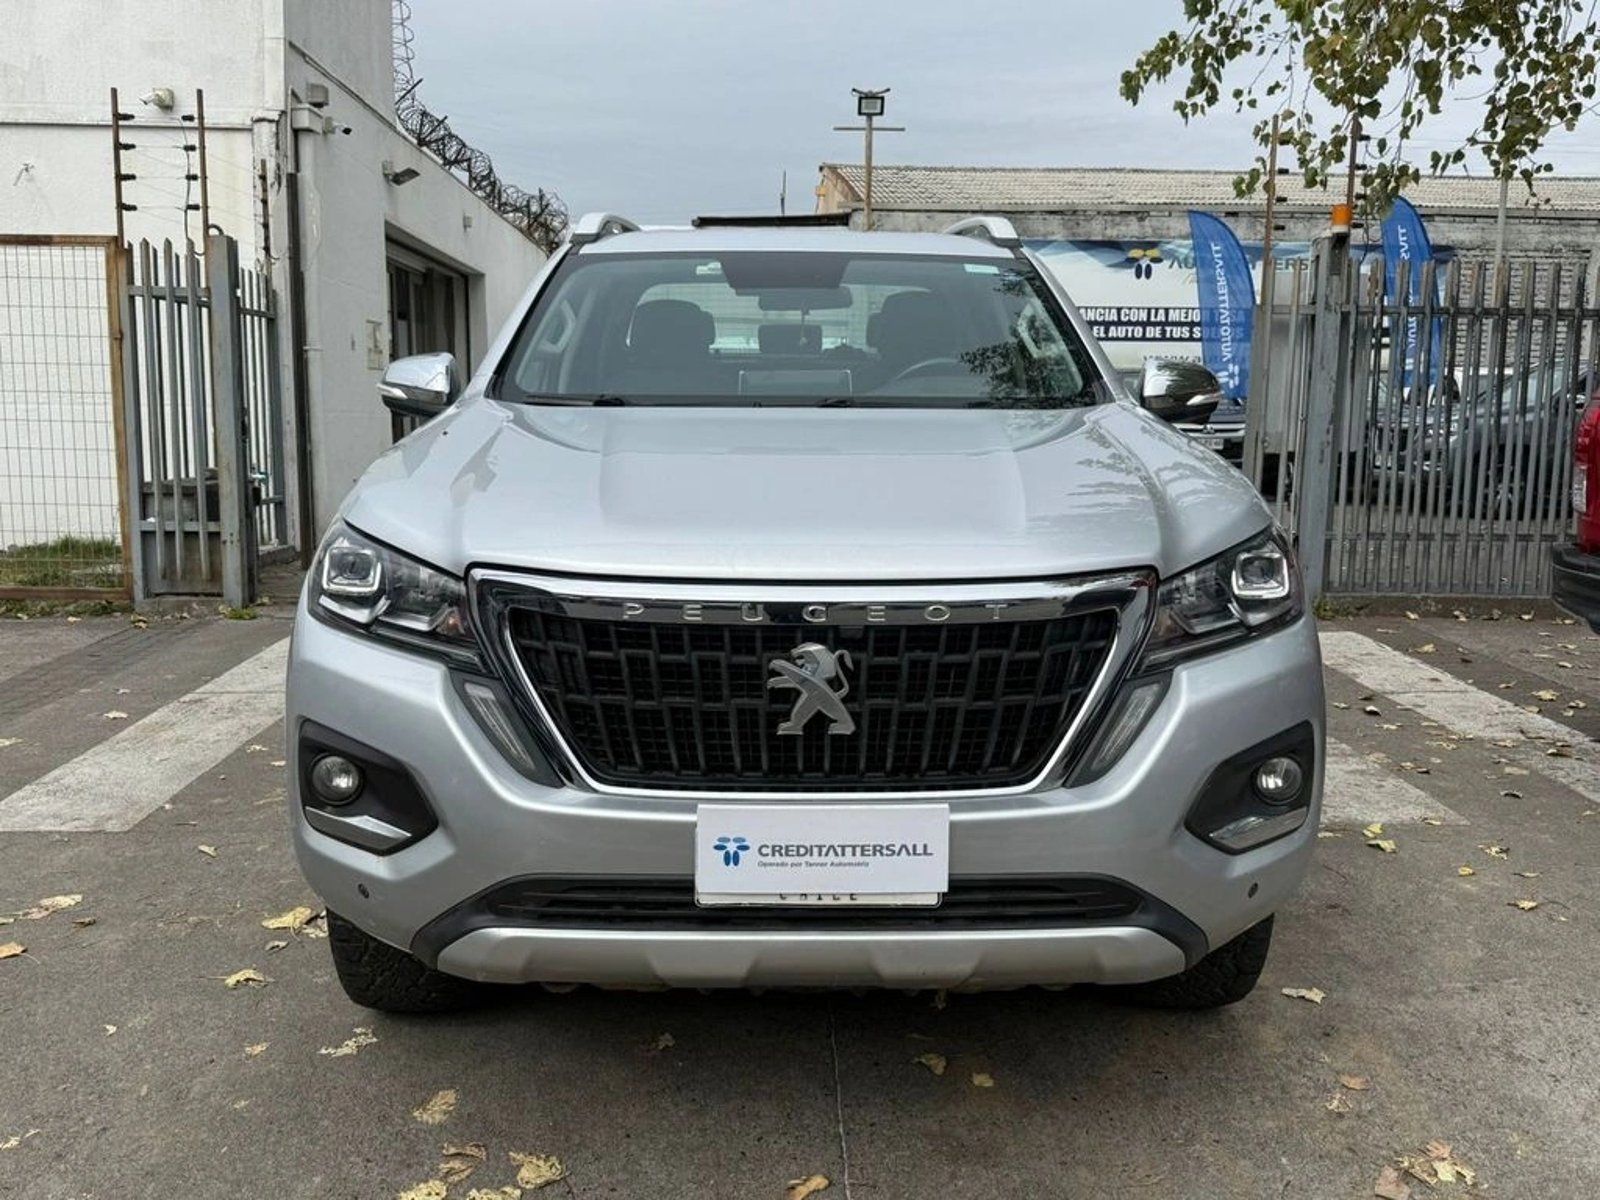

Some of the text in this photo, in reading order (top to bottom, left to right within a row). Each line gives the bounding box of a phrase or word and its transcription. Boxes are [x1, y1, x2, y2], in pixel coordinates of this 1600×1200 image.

[1120, 308, 1148, 322] CON
[1149, 308, 1166, 322] LA
[1092, 325, 1106, 338] EL
[1107, 325, 1143, 338] AUTO
[1145, 325, 1162, 338] DE
[1164, 325, 1190, 338] TUS
[621, 602, 1008, 622] PEUGEOT
[757, 843, 933, 858] CREDITATTERSALL
[757, 860, 789, 869] Operado
